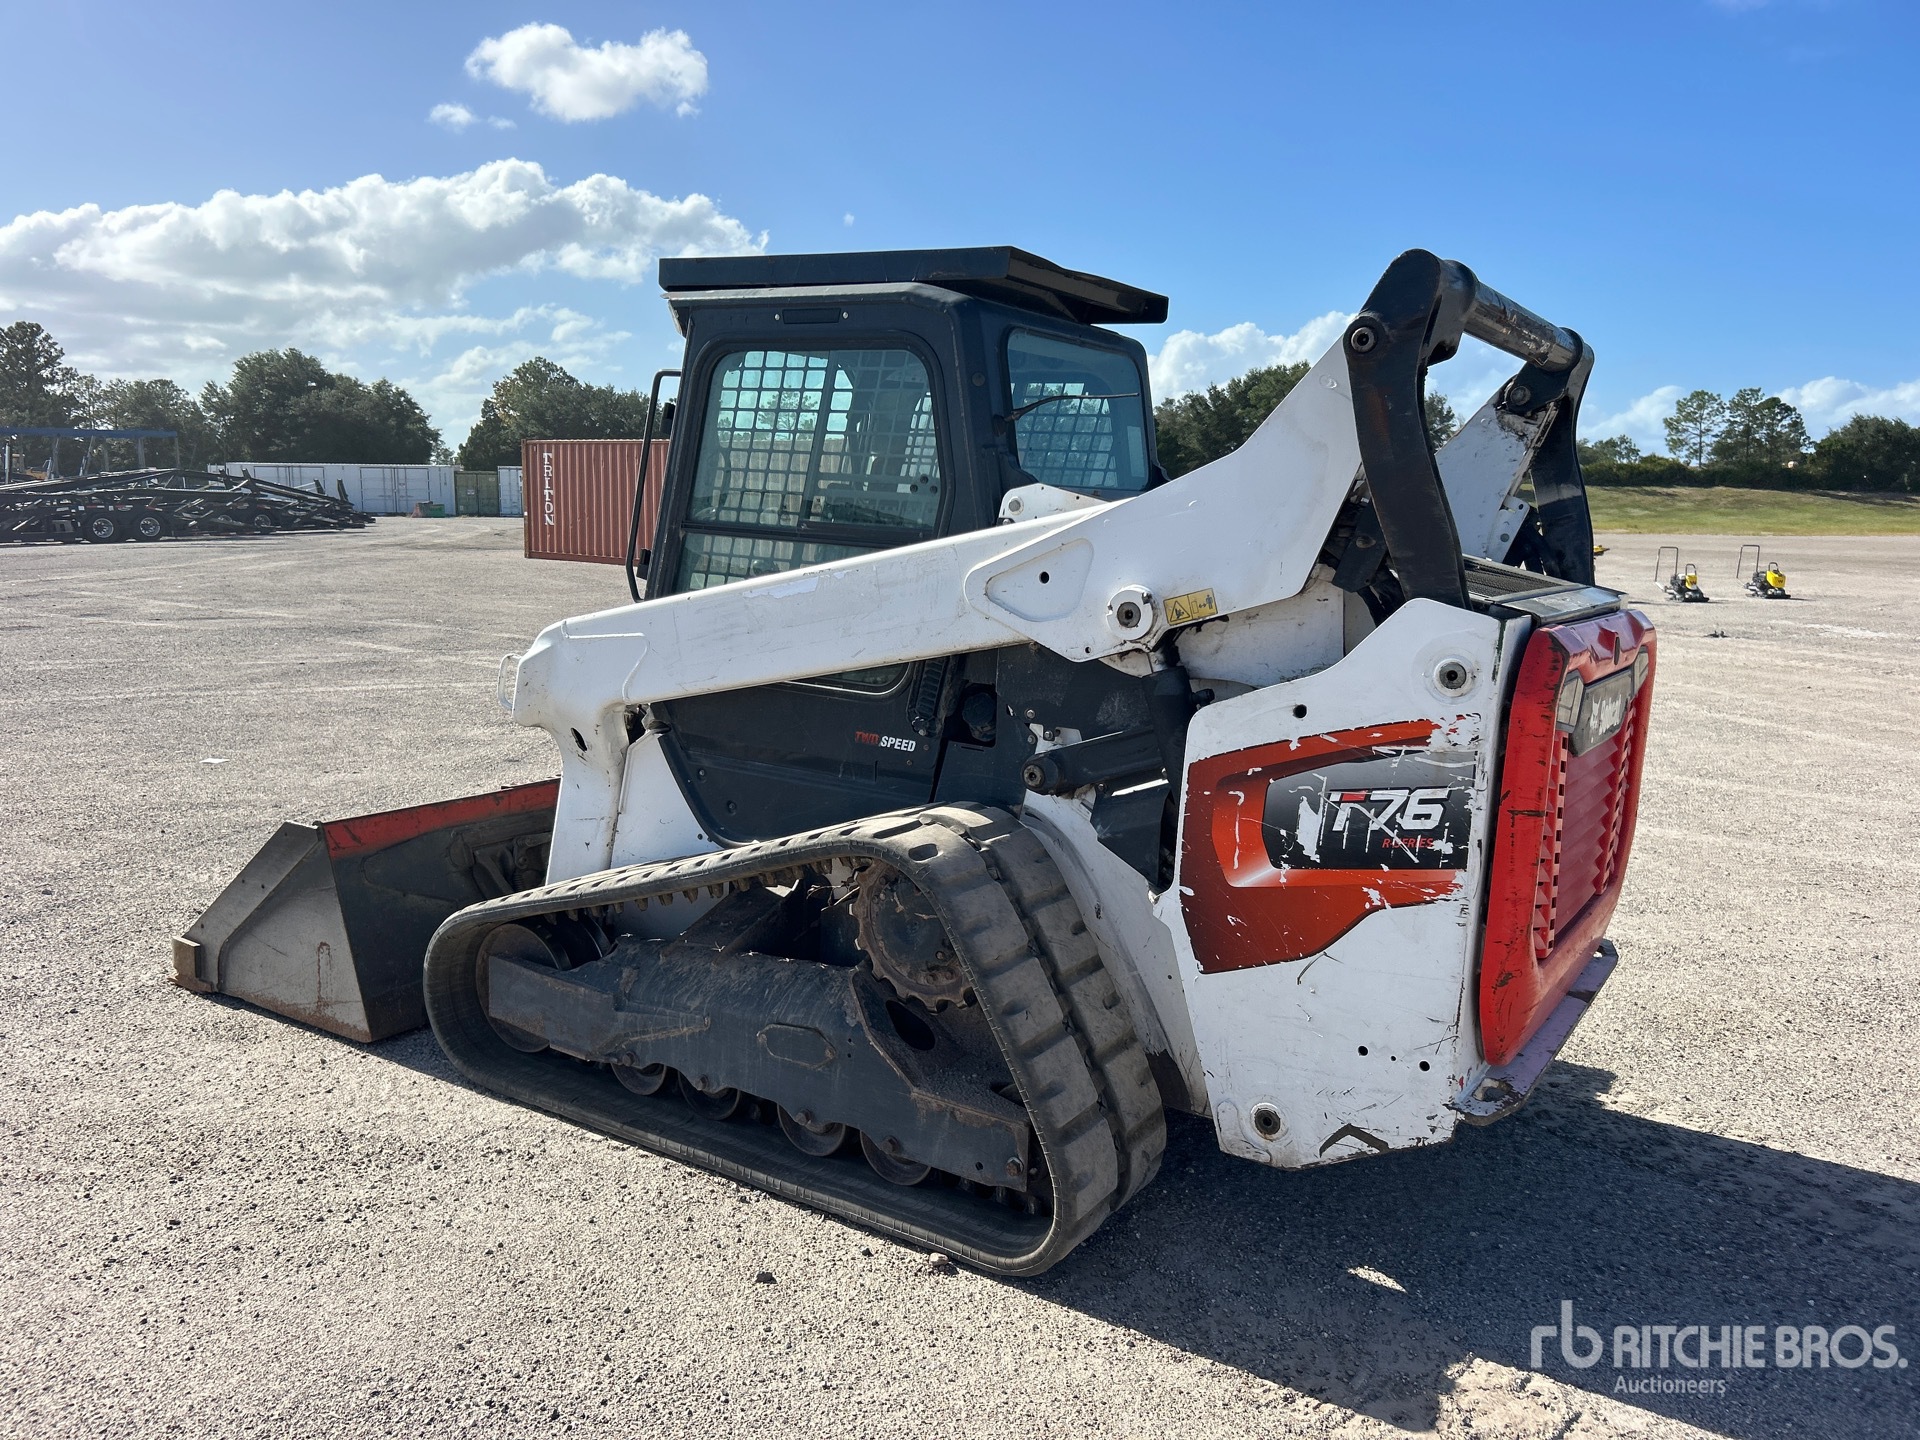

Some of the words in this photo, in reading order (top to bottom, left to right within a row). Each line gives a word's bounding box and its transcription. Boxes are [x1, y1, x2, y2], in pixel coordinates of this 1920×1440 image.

[543, 452, 555, 526] TRITON
[880, 735, 916, 752] SPEED
[1329, 789, 1450, 831] T76
